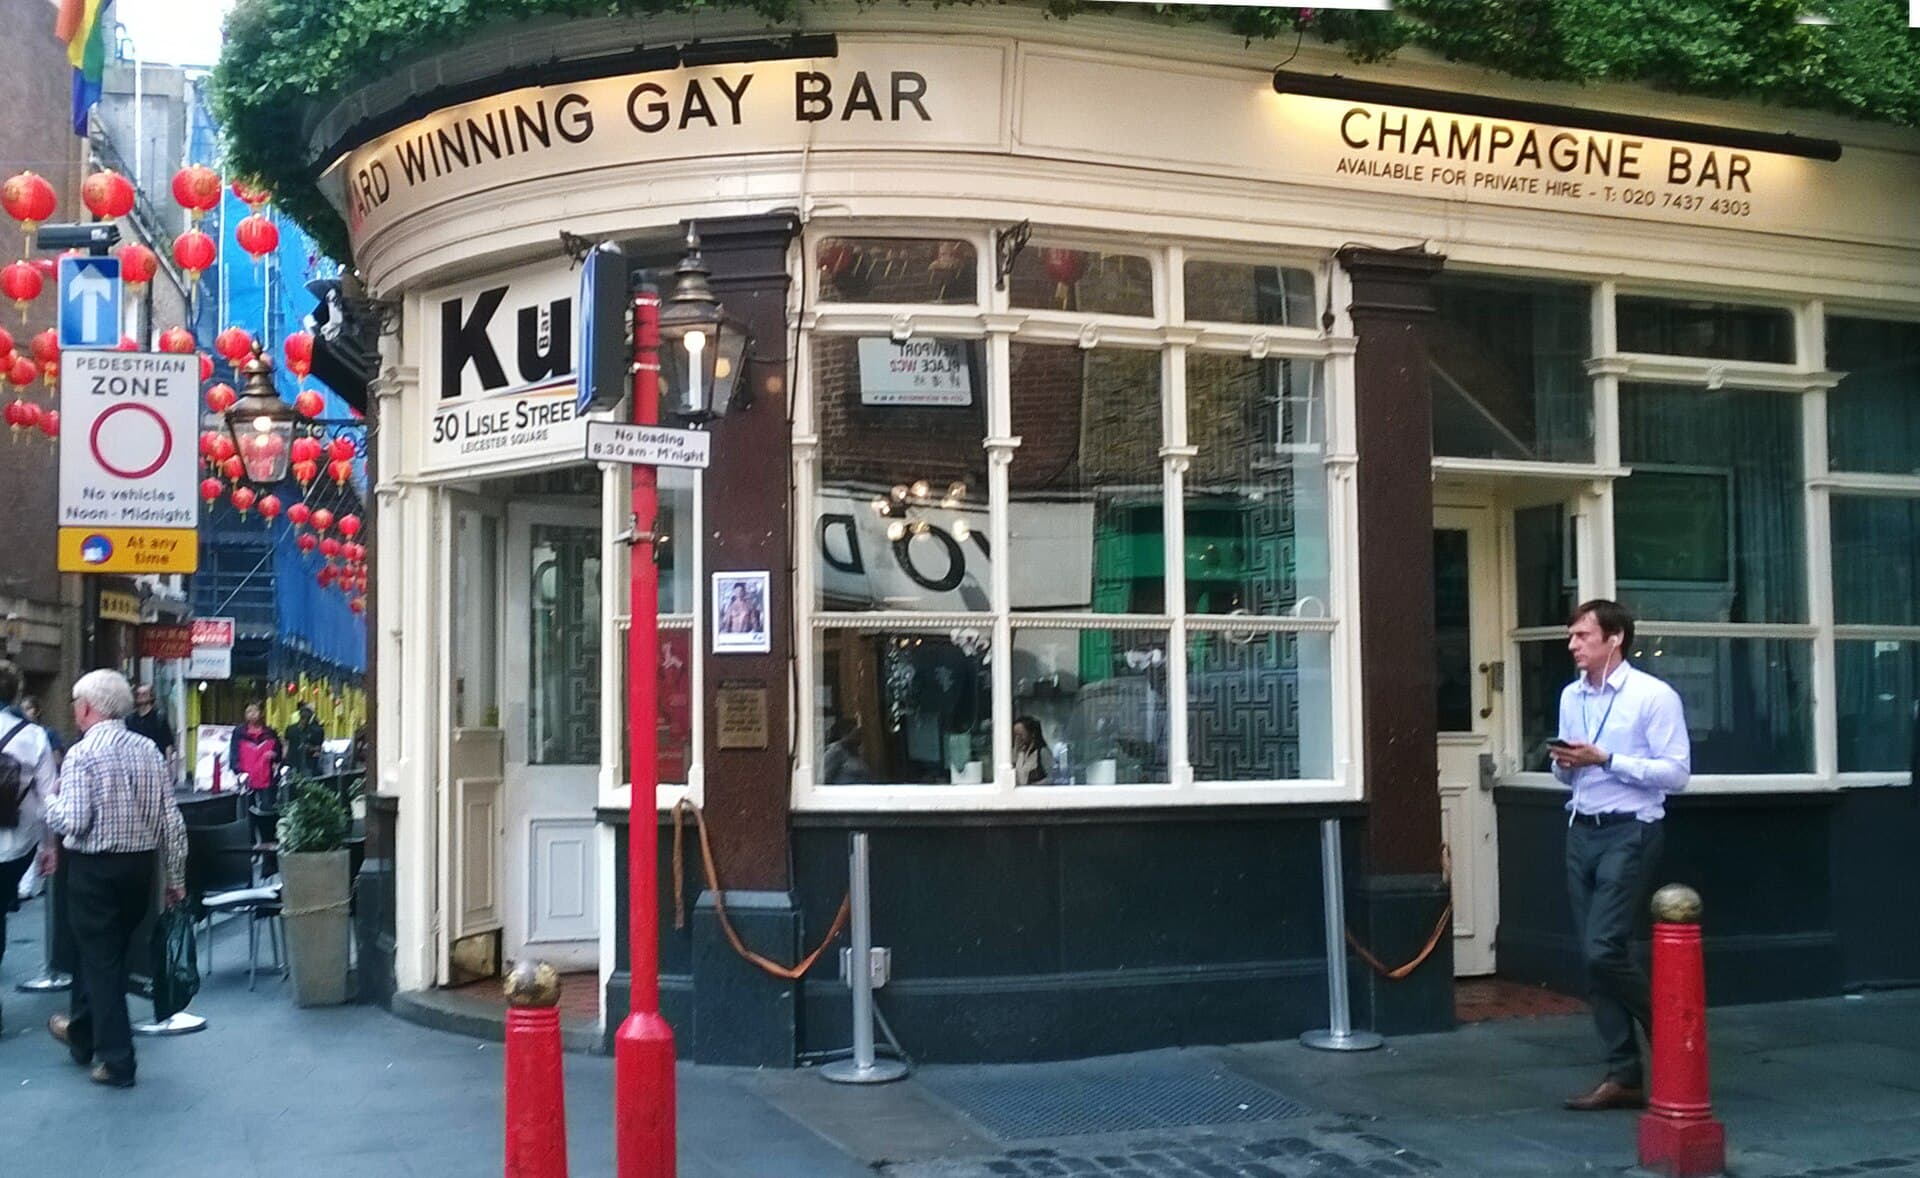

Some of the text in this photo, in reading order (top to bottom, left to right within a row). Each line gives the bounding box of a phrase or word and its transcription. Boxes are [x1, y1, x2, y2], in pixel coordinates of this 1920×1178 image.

[394, 92, 594, 187] WINNING
[626, 73, 755, 133] GAY
[795, 71, 932, 122] BAR
[1340, 107, 1751, 193] CHAMPAGNE BAR
[1336, 156, 1424, 182] AVAILABLE
[1431, 167, 1467, 186] FOR
[1474, 172, 1538, 194] PRIVATE
[1545, 180, 1582, 198] HIRE
[1604, 186, 1617, 202] T:
[1623, 188, 1656, 206] 020
[1663, 192, 1704, 212] 7437
[1709, 198, 1751, 217] 4303
[538, 309, 549, 350] Bar
[441, 285, 572, 399] Ku
[76, 357, 186, 373] PEDESTRIAN
[91, 376, 169, 397] ZONE
[432, 412, 460, 443] 30
[615, 429, 685, 447] No loading
[461, 428, 549, 454] LEICESTER SQUARE
[593, 442, 625, 456] 8.30
[627, 448, 647, 457] am
[82, 487, 176, 501] No vehicles
[65, 506, 108, 520] Noon
[120, 507, 192, 522] Midnight
[127, 536, 178, 552] At any
[134, 552, 169, 564] time
